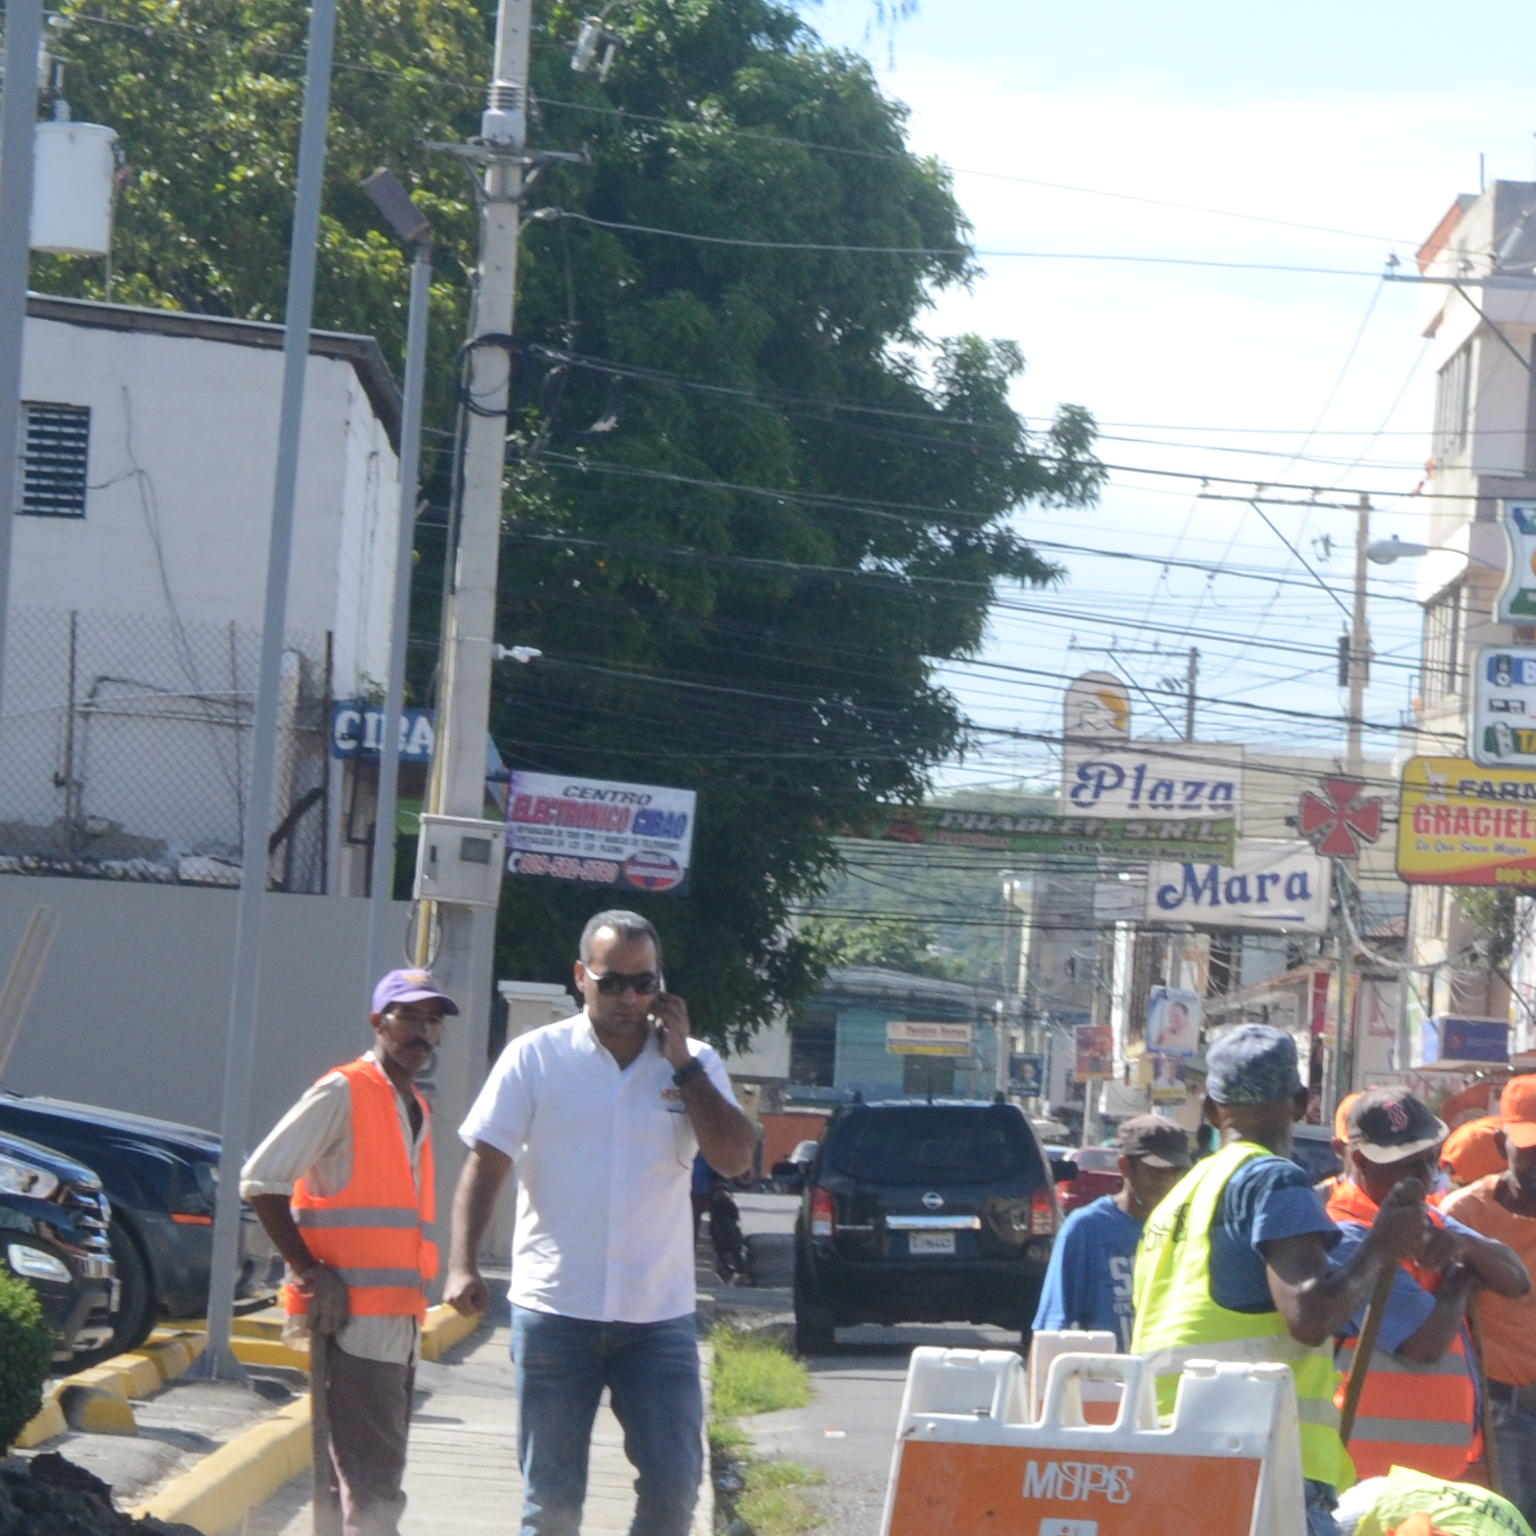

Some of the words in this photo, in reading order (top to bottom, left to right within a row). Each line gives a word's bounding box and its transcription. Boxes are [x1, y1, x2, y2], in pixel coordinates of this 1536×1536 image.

[562, 785, 653, 806] CENTRO
[1069, 761, 1236, 811] Plaza
[1156, 862, 1312, 910] Mara
